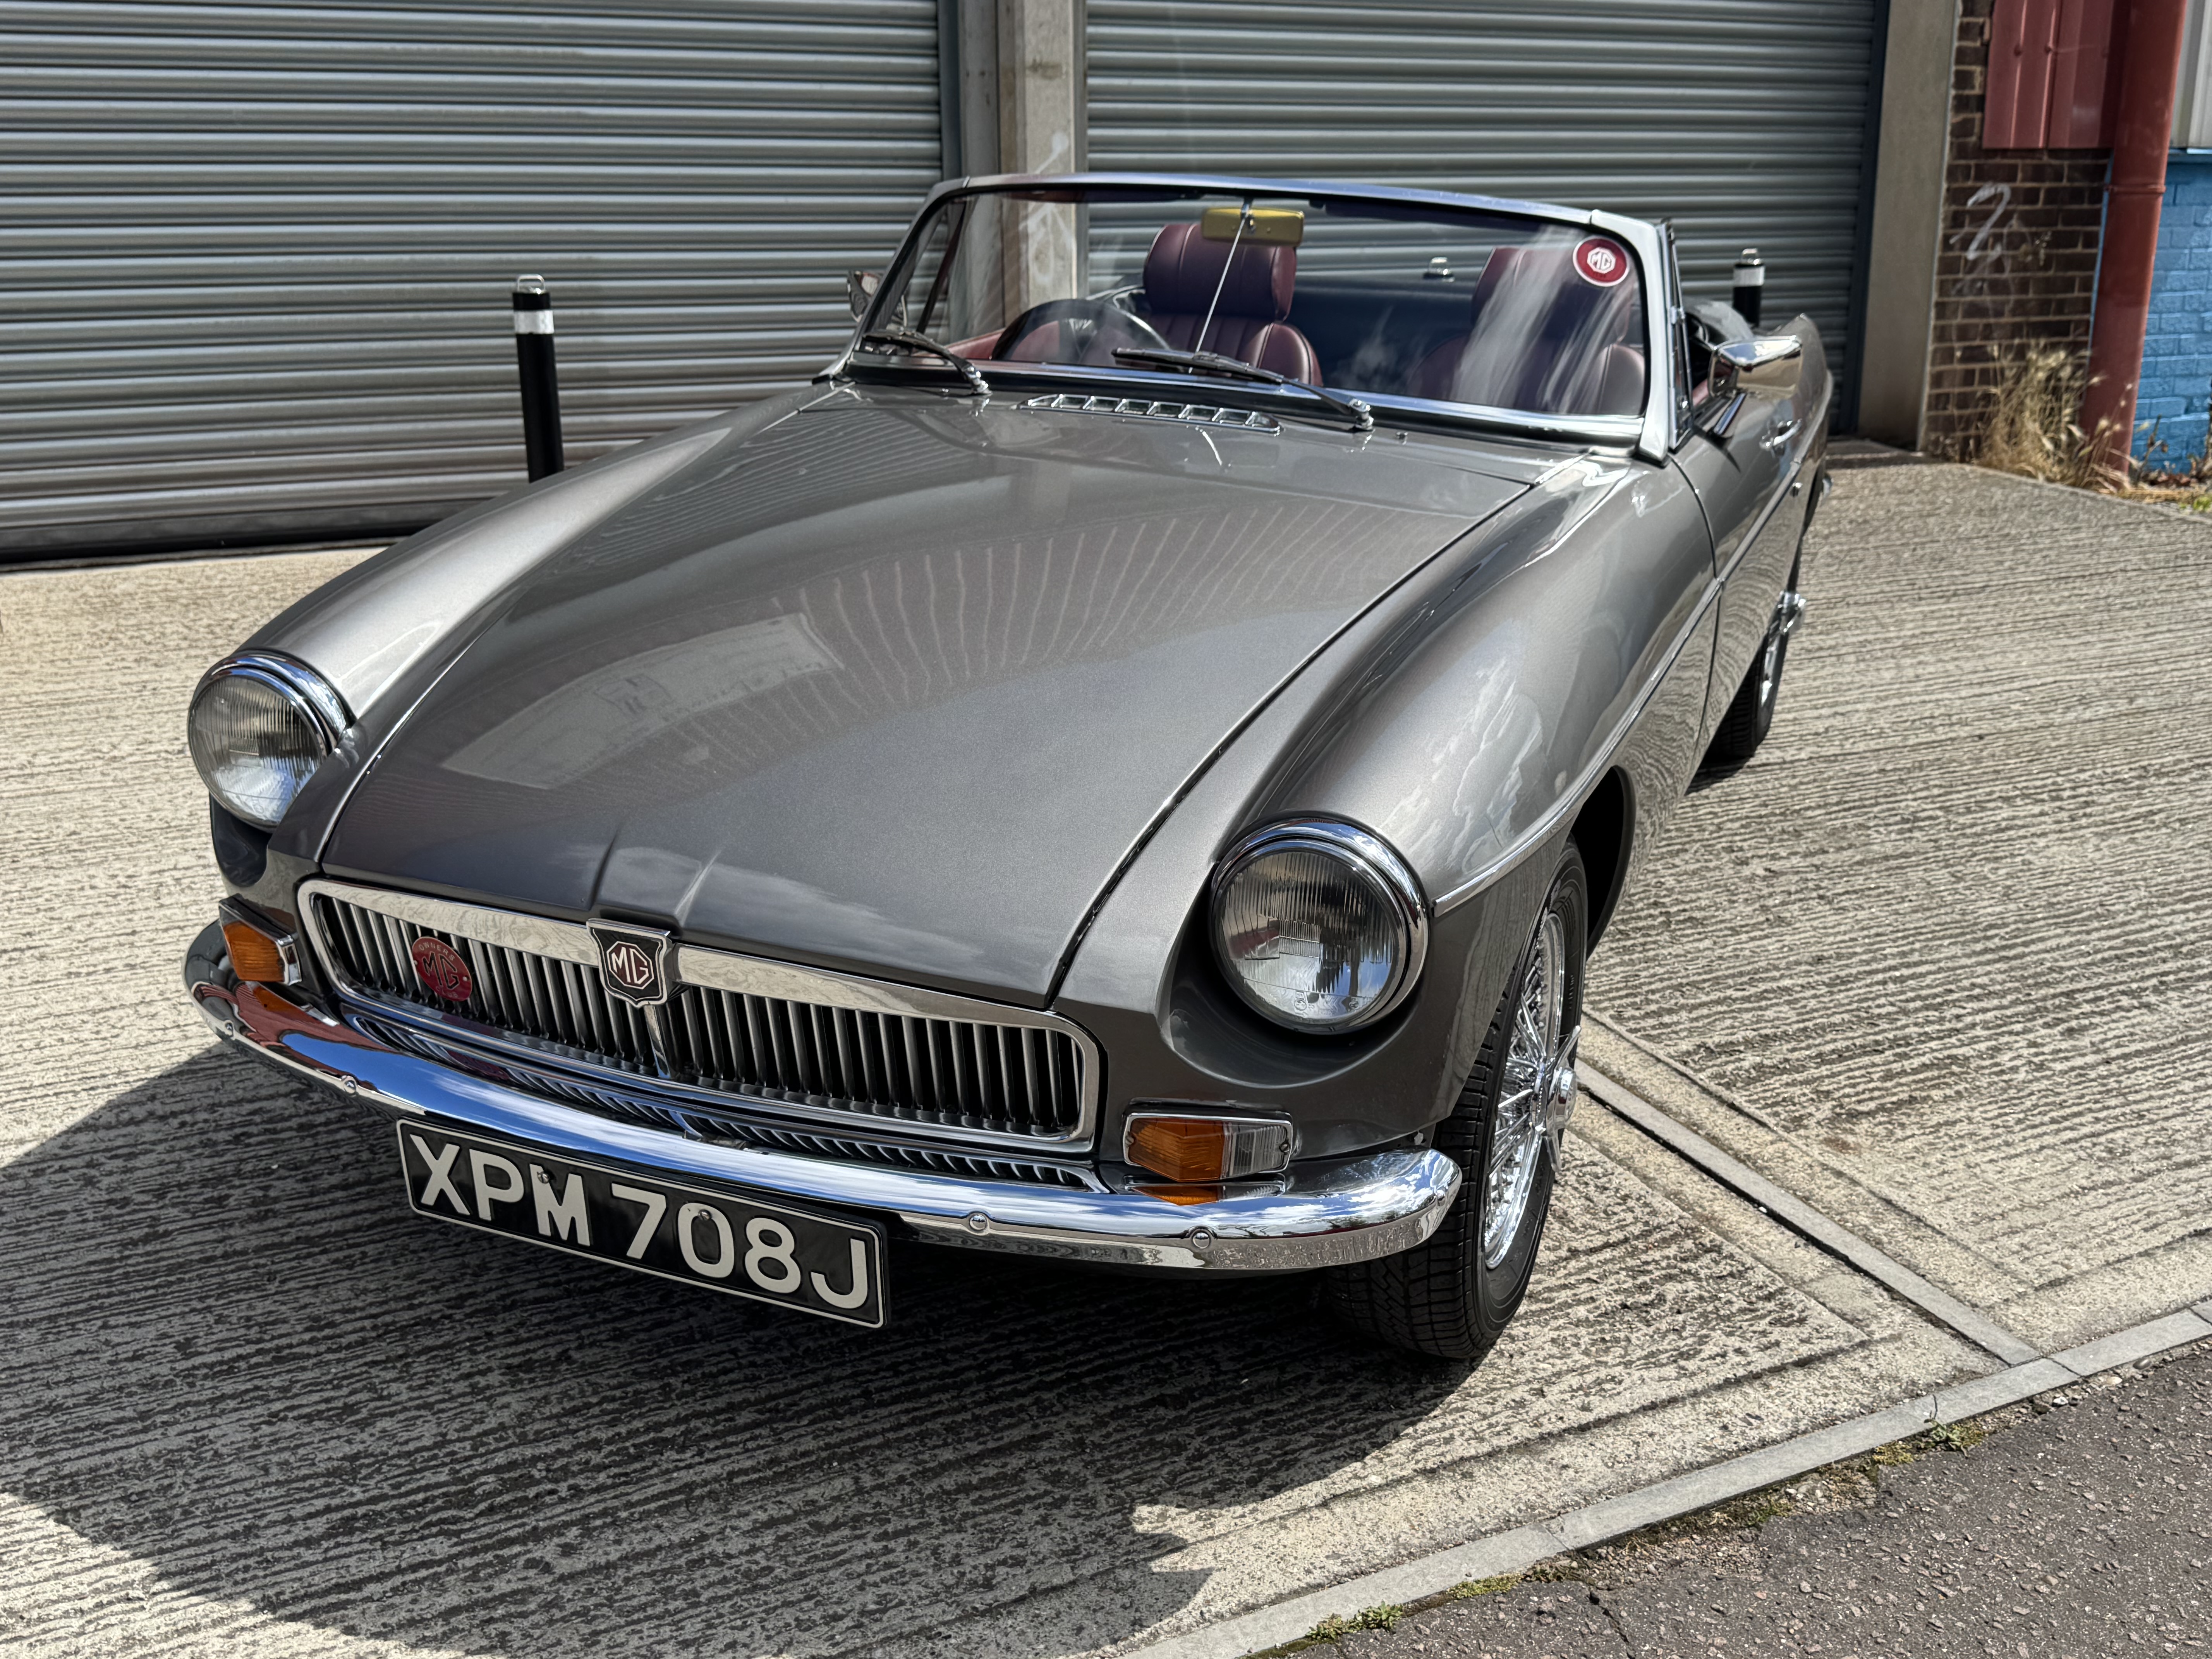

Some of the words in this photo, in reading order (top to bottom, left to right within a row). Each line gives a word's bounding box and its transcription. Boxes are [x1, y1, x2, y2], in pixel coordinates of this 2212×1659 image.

[1590, 251, 1613, 271] MG
[418, 942, 455, 961] OWNERS
[611, 946, 649, 984] MG
[422, 951, 460, 990] MG
[435, 986, 459, 998] CLUB
[409, 1134, 591, 1247] XPM
[611, 1183, 868, 1309] 708J
